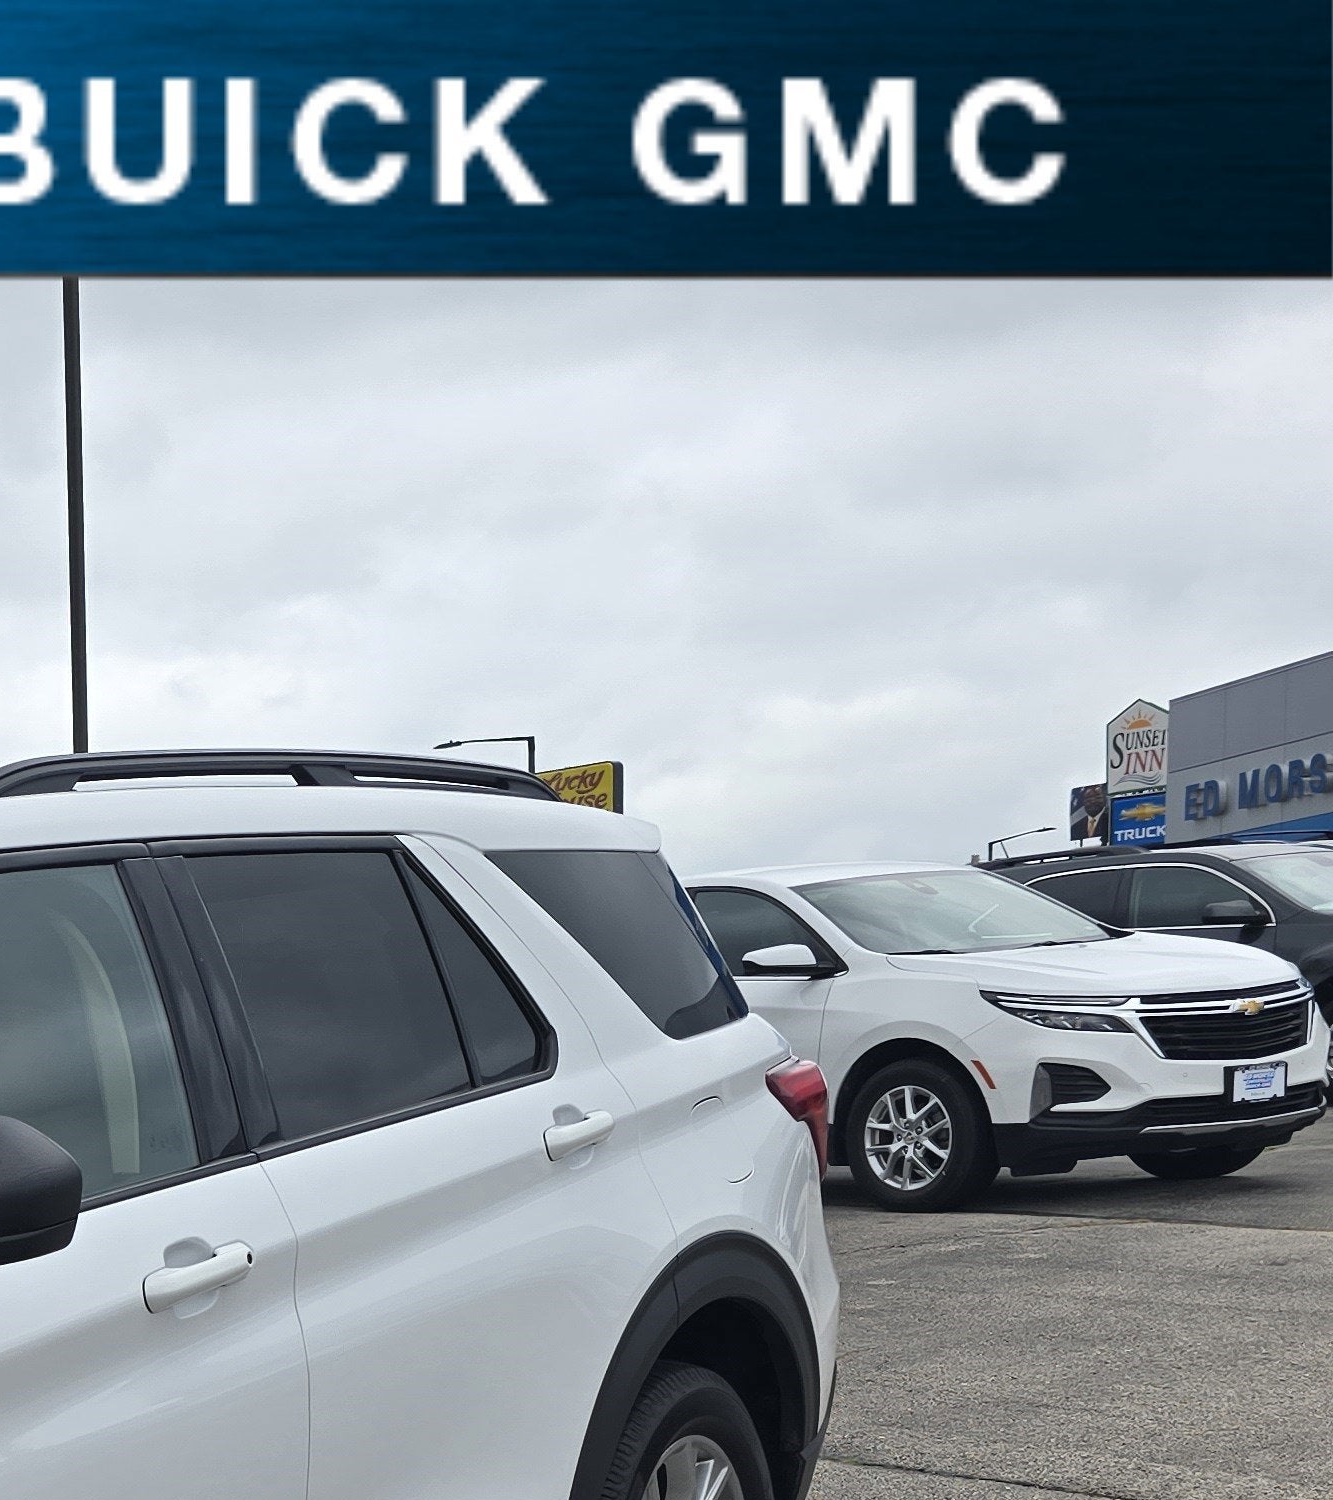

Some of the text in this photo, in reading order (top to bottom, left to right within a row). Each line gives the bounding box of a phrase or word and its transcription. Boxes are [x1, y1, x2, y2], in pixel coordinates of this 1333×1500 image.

[1110, 729, 1166, 769] SUNSET
[1124, 748, 1165, 775] INN
[1185, 753, 1328, 821] ED MORS
[1113, 825, 1167, 842] TRUCK
